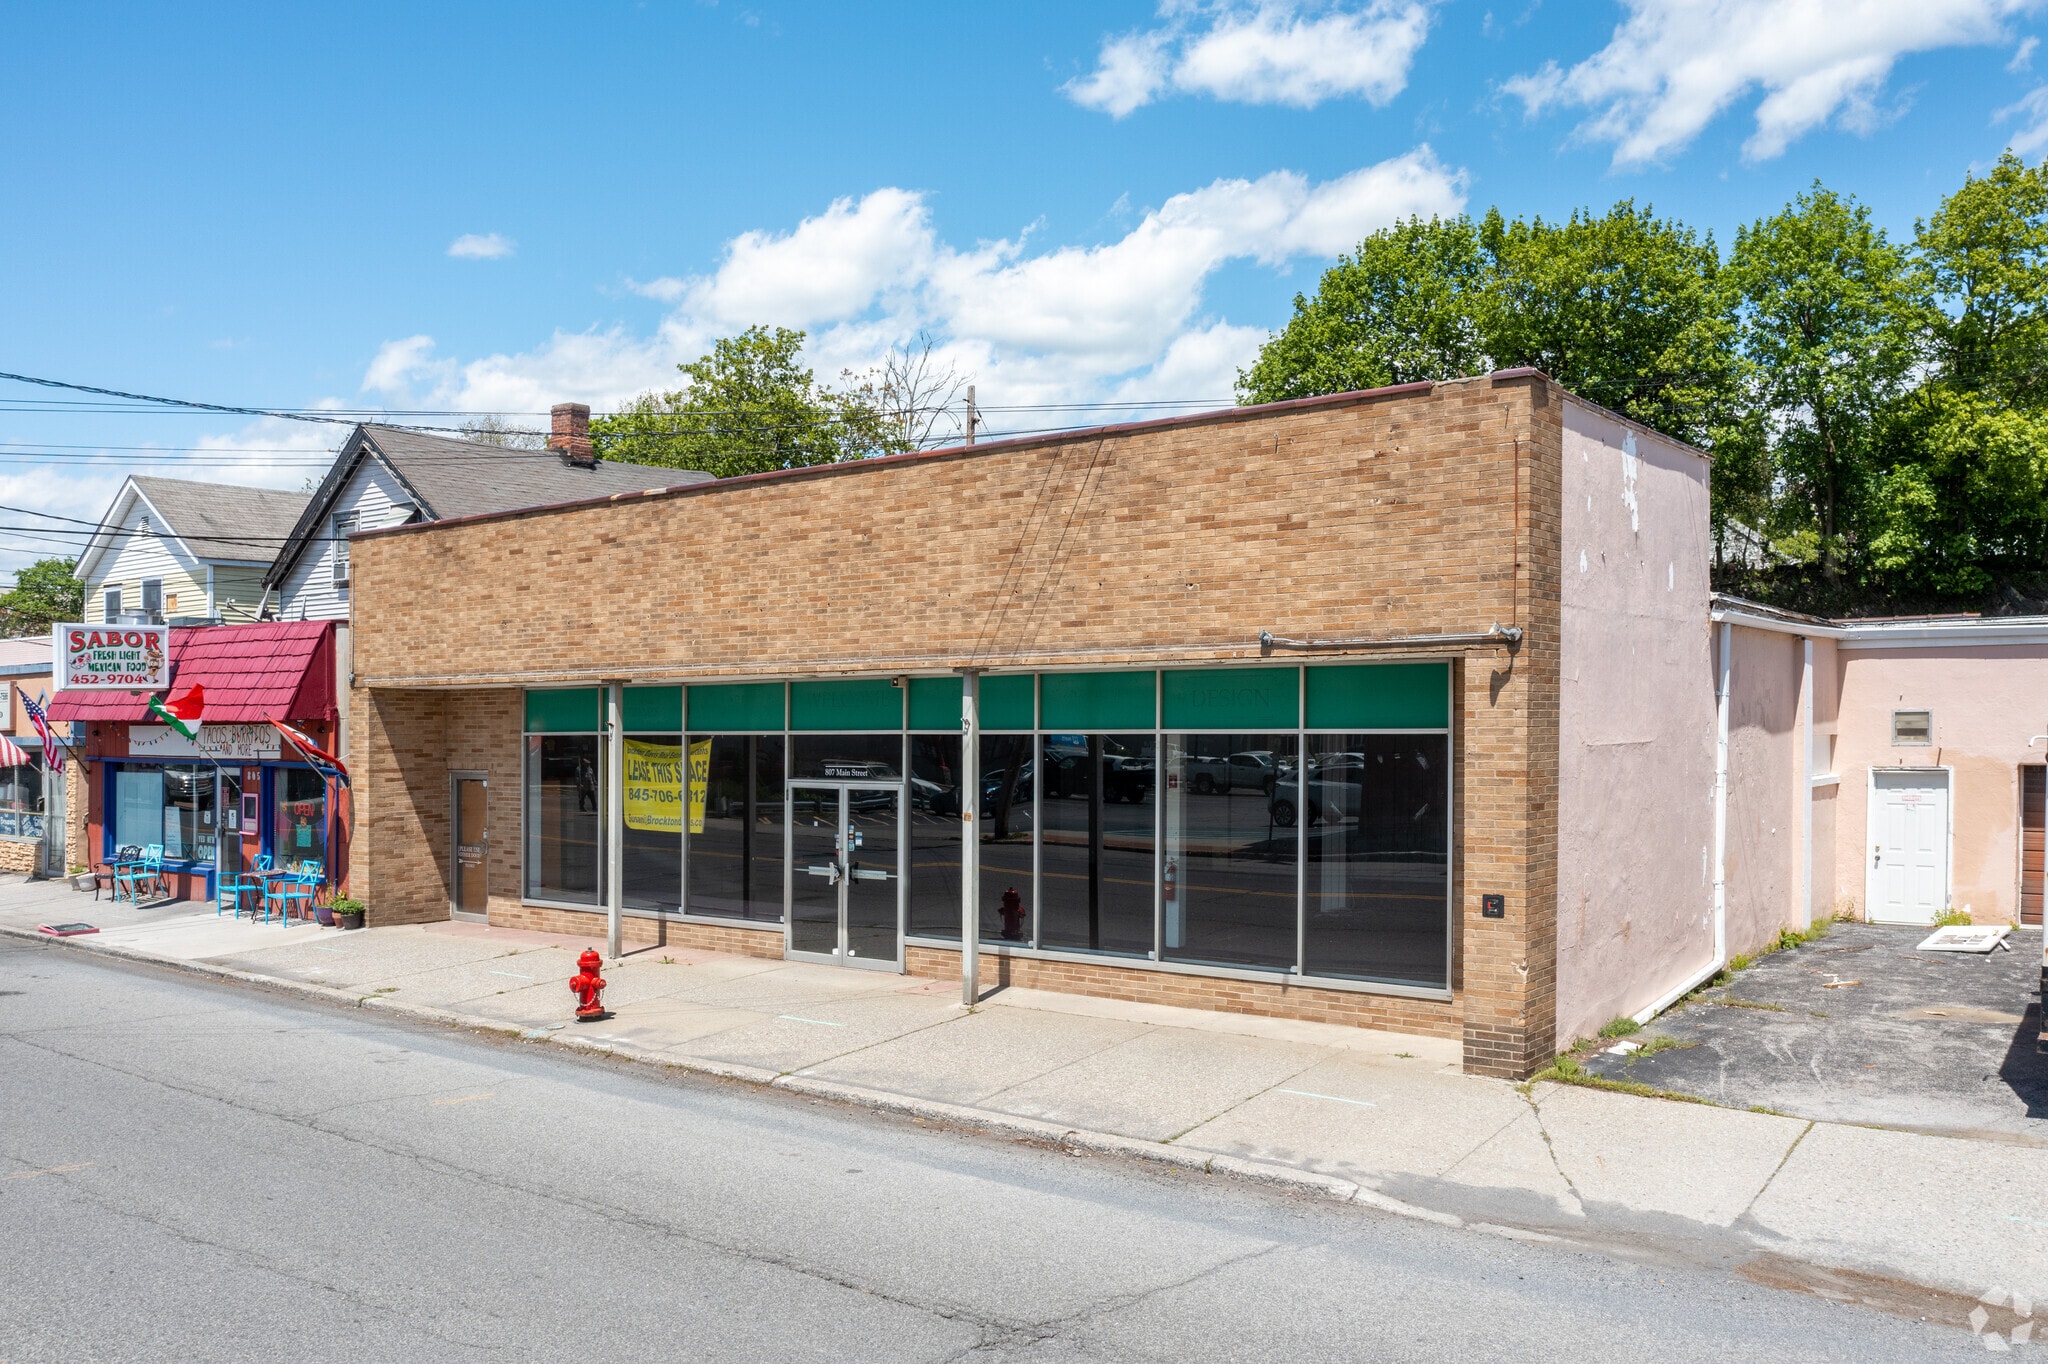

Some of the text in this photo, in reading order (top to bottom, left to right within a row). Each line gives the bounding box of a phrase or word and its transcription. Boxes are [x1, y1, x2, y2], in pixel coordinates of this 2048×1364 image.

[70, 630, 162, 653] SABOR
[93, 650, 141, 661] FRESH LIGHT
[88, 662, 146, 672] MEXICAN FOOD
[70, 673, 144, 685] 452-9704
[202, 726, 227, 744] TACOS
[237, 743, 252, 756] MORE
[627, 759, 707, 784] LEASE THIS SACE
[825, 768, 868, 777] 807 Main Street
[293, 802, 315, 817] OPEN
